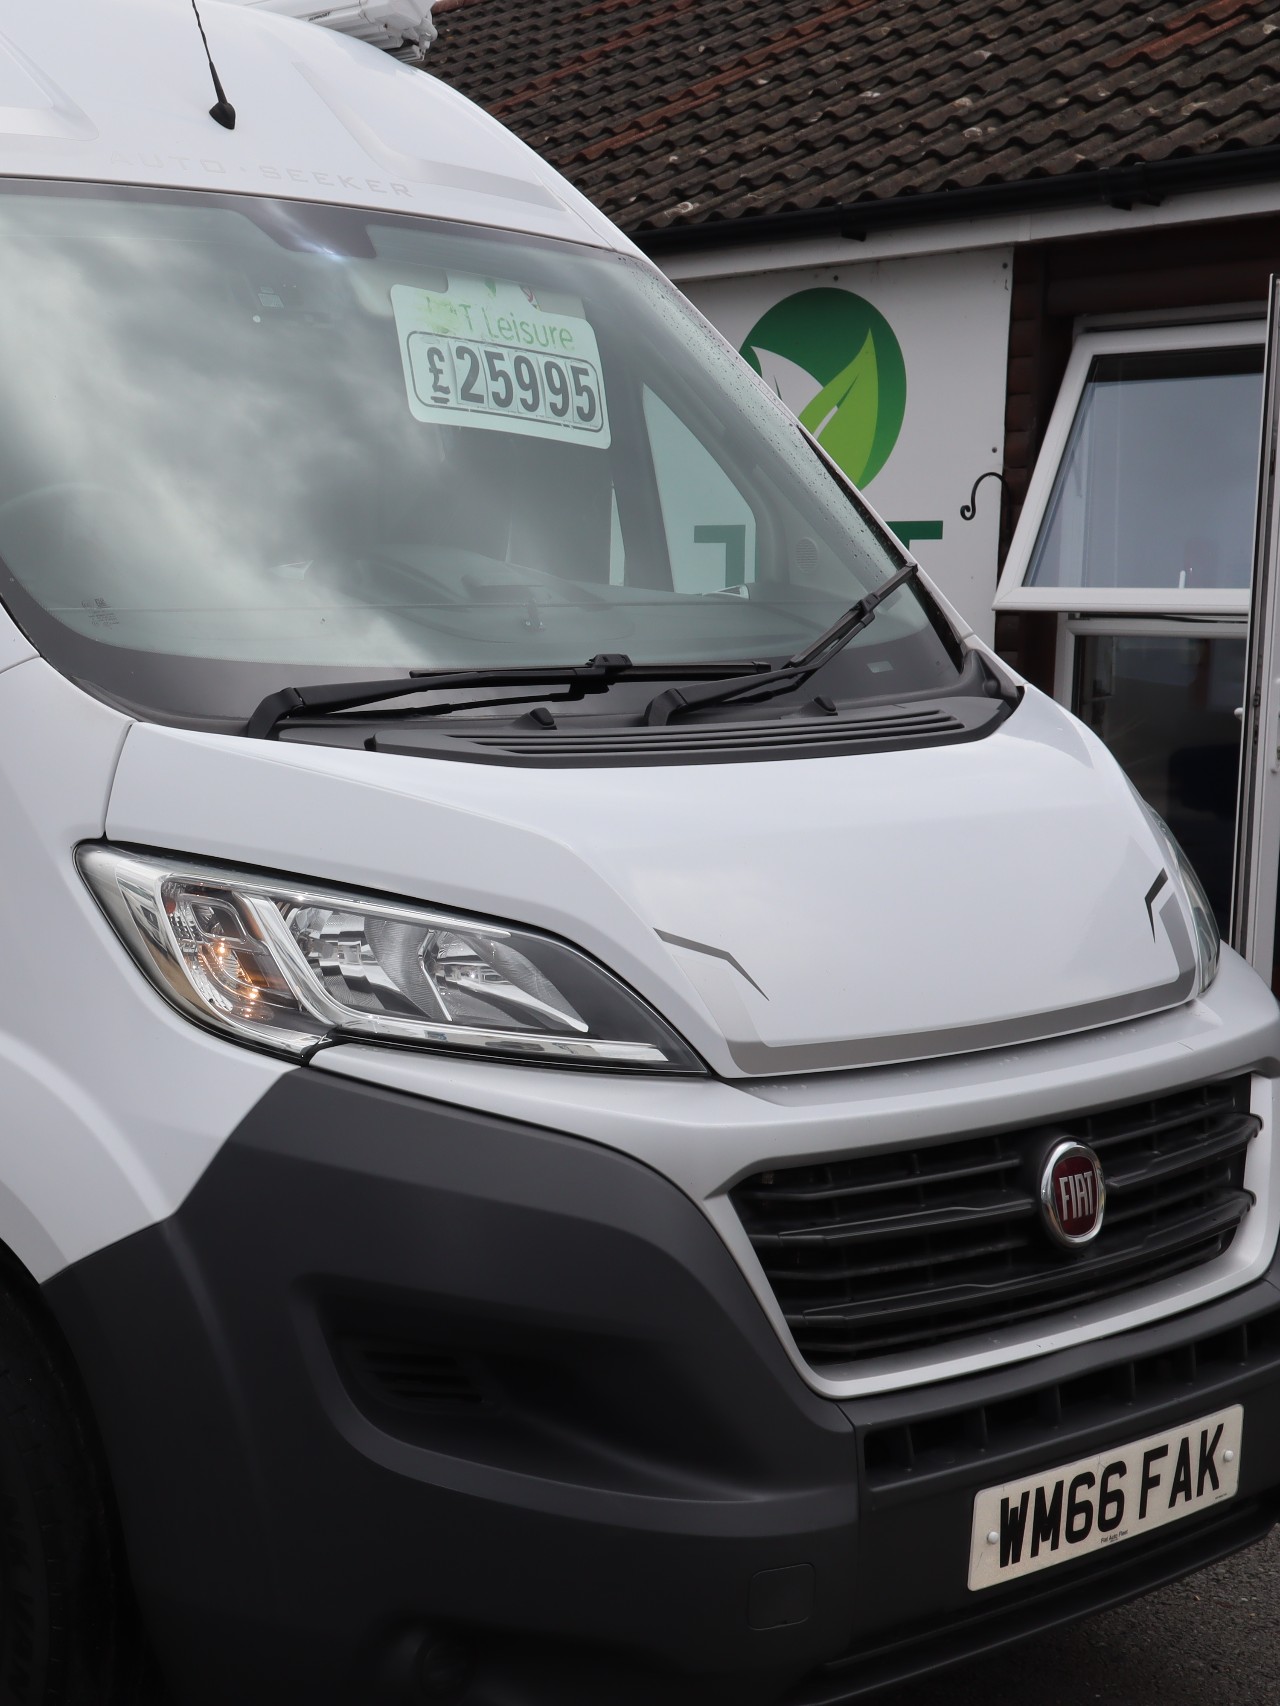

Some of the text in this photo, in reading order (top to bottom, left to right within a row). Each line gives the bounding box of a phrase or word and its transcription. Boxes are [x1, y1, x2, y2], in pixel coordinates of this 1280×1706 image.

[110, 150, 414, 198] AUTO SEEKER
[482, 307, 574, 350] Leisure
[426, 345, 597, 422] £25995
[1059, 1170, 1094, 1220] FIAT
[999, 1422, 1224, 1569] WM66 FAK
